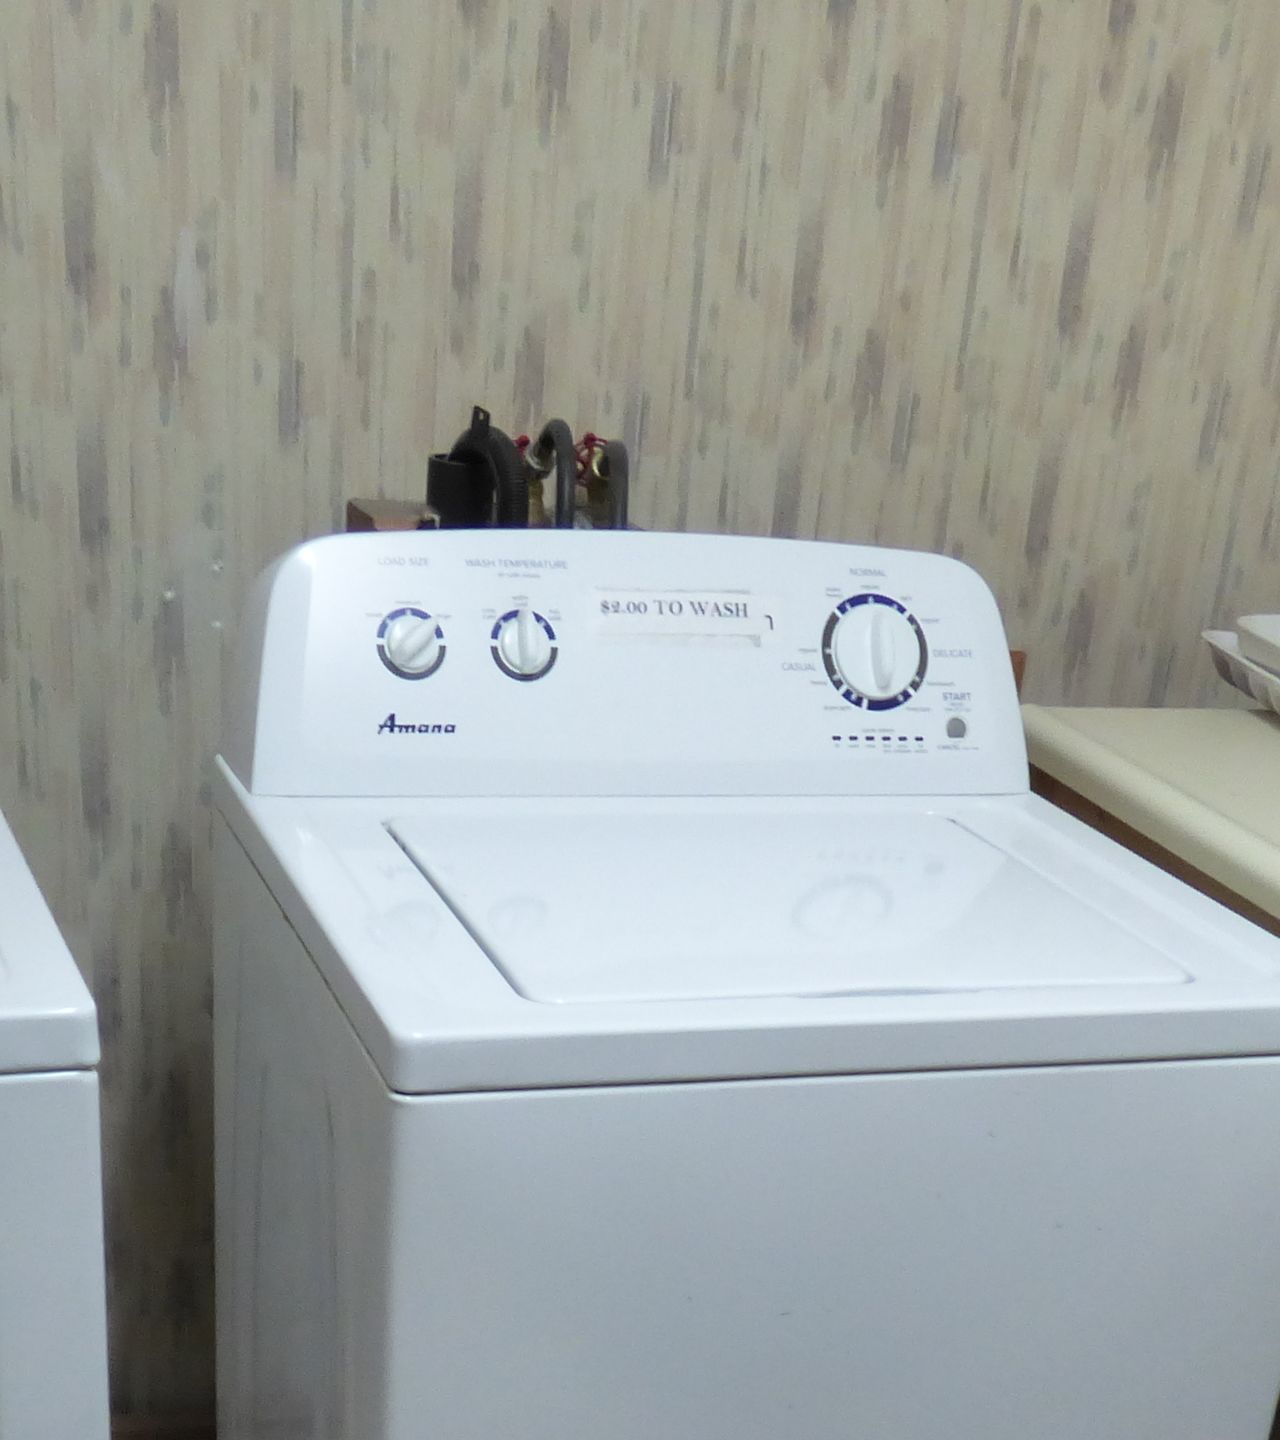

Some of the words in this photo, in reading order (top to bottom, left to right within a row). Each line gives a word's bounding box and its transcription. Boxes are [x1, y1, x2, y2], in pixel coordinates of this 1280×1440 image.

[377, 556, 407, 567] LOAD
[408, 556, 430, 567] SIZE
[464, 558, 495, 568] WASH
[497, 558, 569, 570] TEMPERATURE
[849, 567, 888, 577] NORMAL
[599, 598, 649, 616] $2.00
[652, 599, 684, 617] TO
[687, 600, 750, 619] WASH
[931, 648, 973, 659] DELICATE
[780, 661, 817, 672] CASUAL
[942, 691, 972, 701] START
[377, 712, 457, 736] Amana
